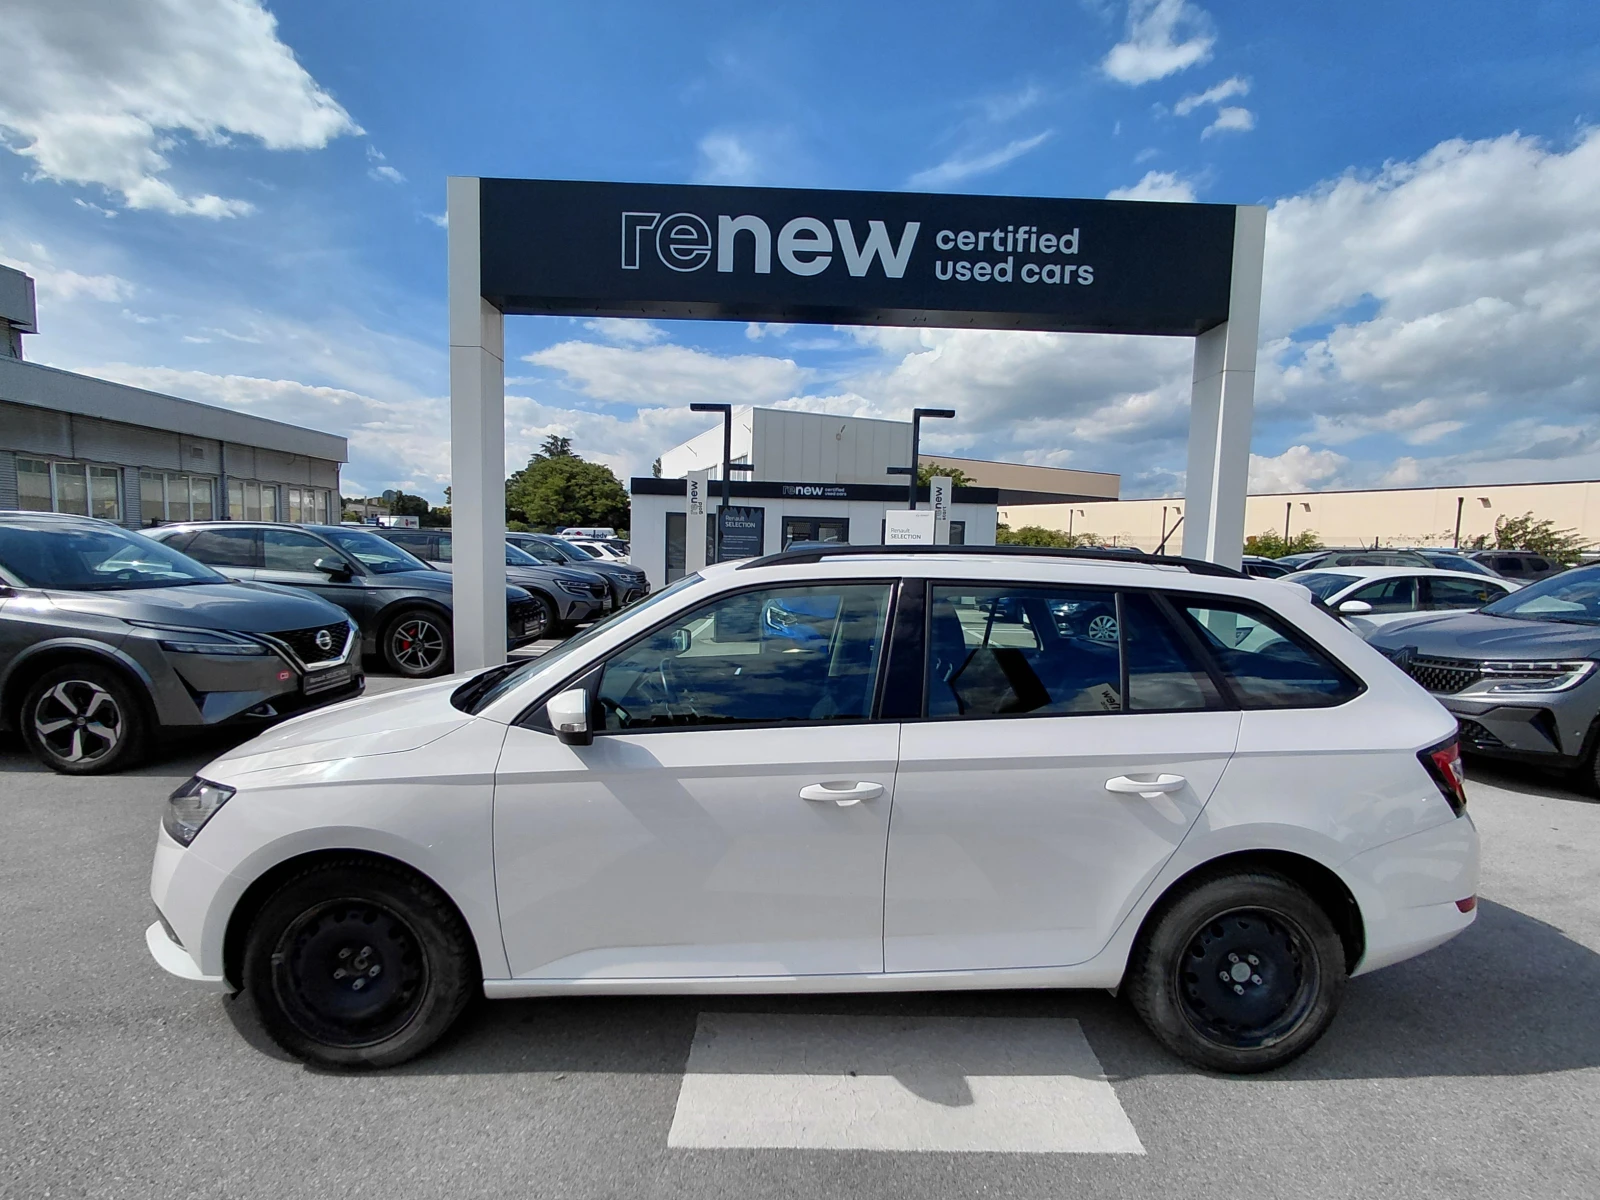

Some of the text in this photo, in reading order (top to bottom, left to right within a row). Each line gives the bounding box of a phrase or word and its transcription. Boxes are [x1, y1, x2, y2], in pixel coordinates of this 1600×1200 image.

[621, 212, 921, 278] renew
[936, 226, 1080, 255] certified
[935, 257, 1095, 286] used cars
[783, 485, 823, 495] renew
